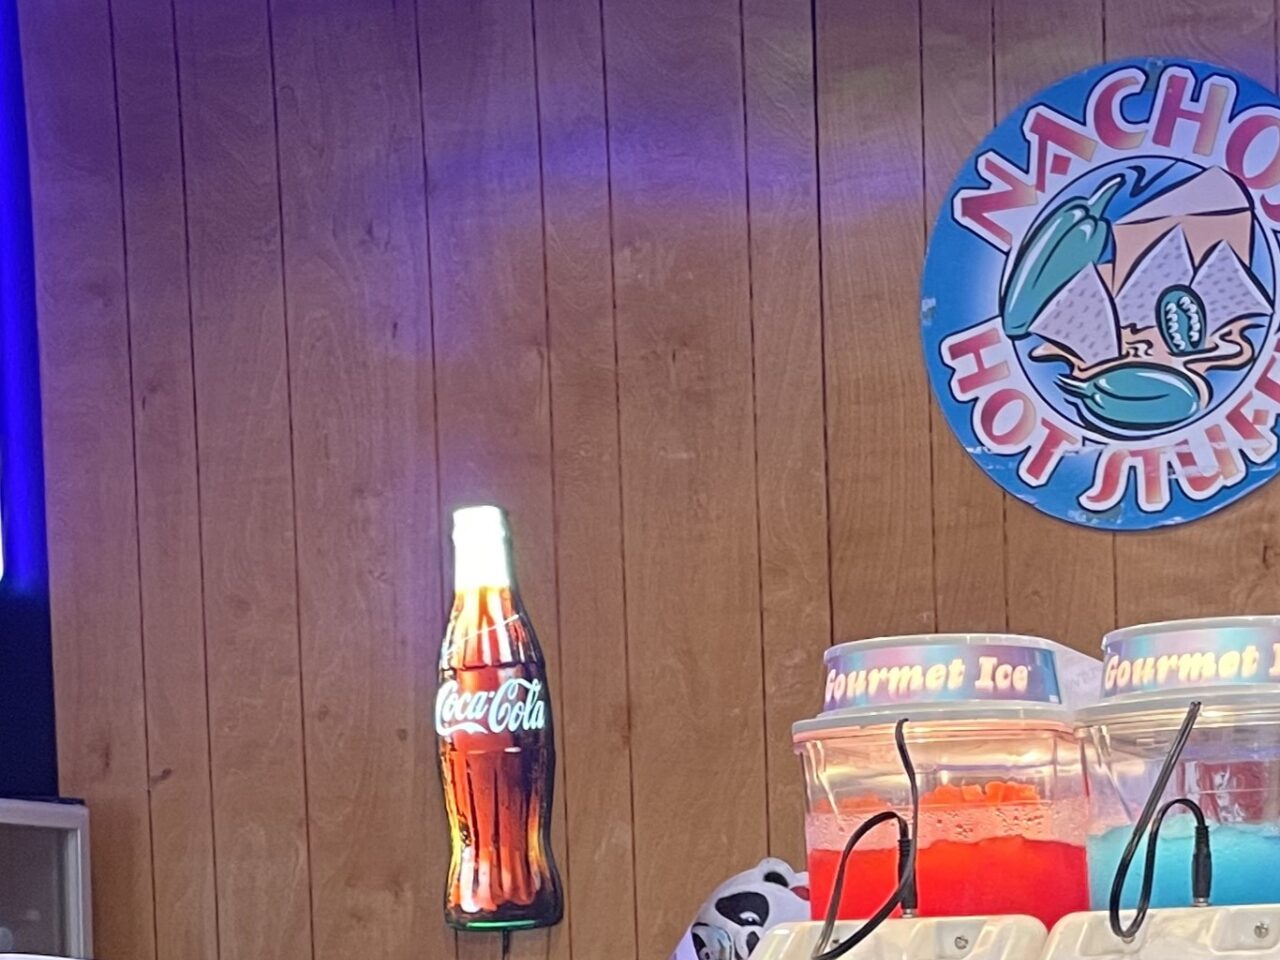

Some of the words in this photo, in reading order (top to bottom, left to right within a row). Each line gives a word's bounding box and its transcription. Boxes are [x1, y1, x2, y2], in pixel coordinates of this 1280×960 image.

[943, 326, 1082, 484] HOT
[825, 659, 966, 703] Gourmet
[974, 656, 1030, 692] Ice
[1104, 647, 1260, 689] Gourmet
[435, 677, 545, 737] Coca-Cola
